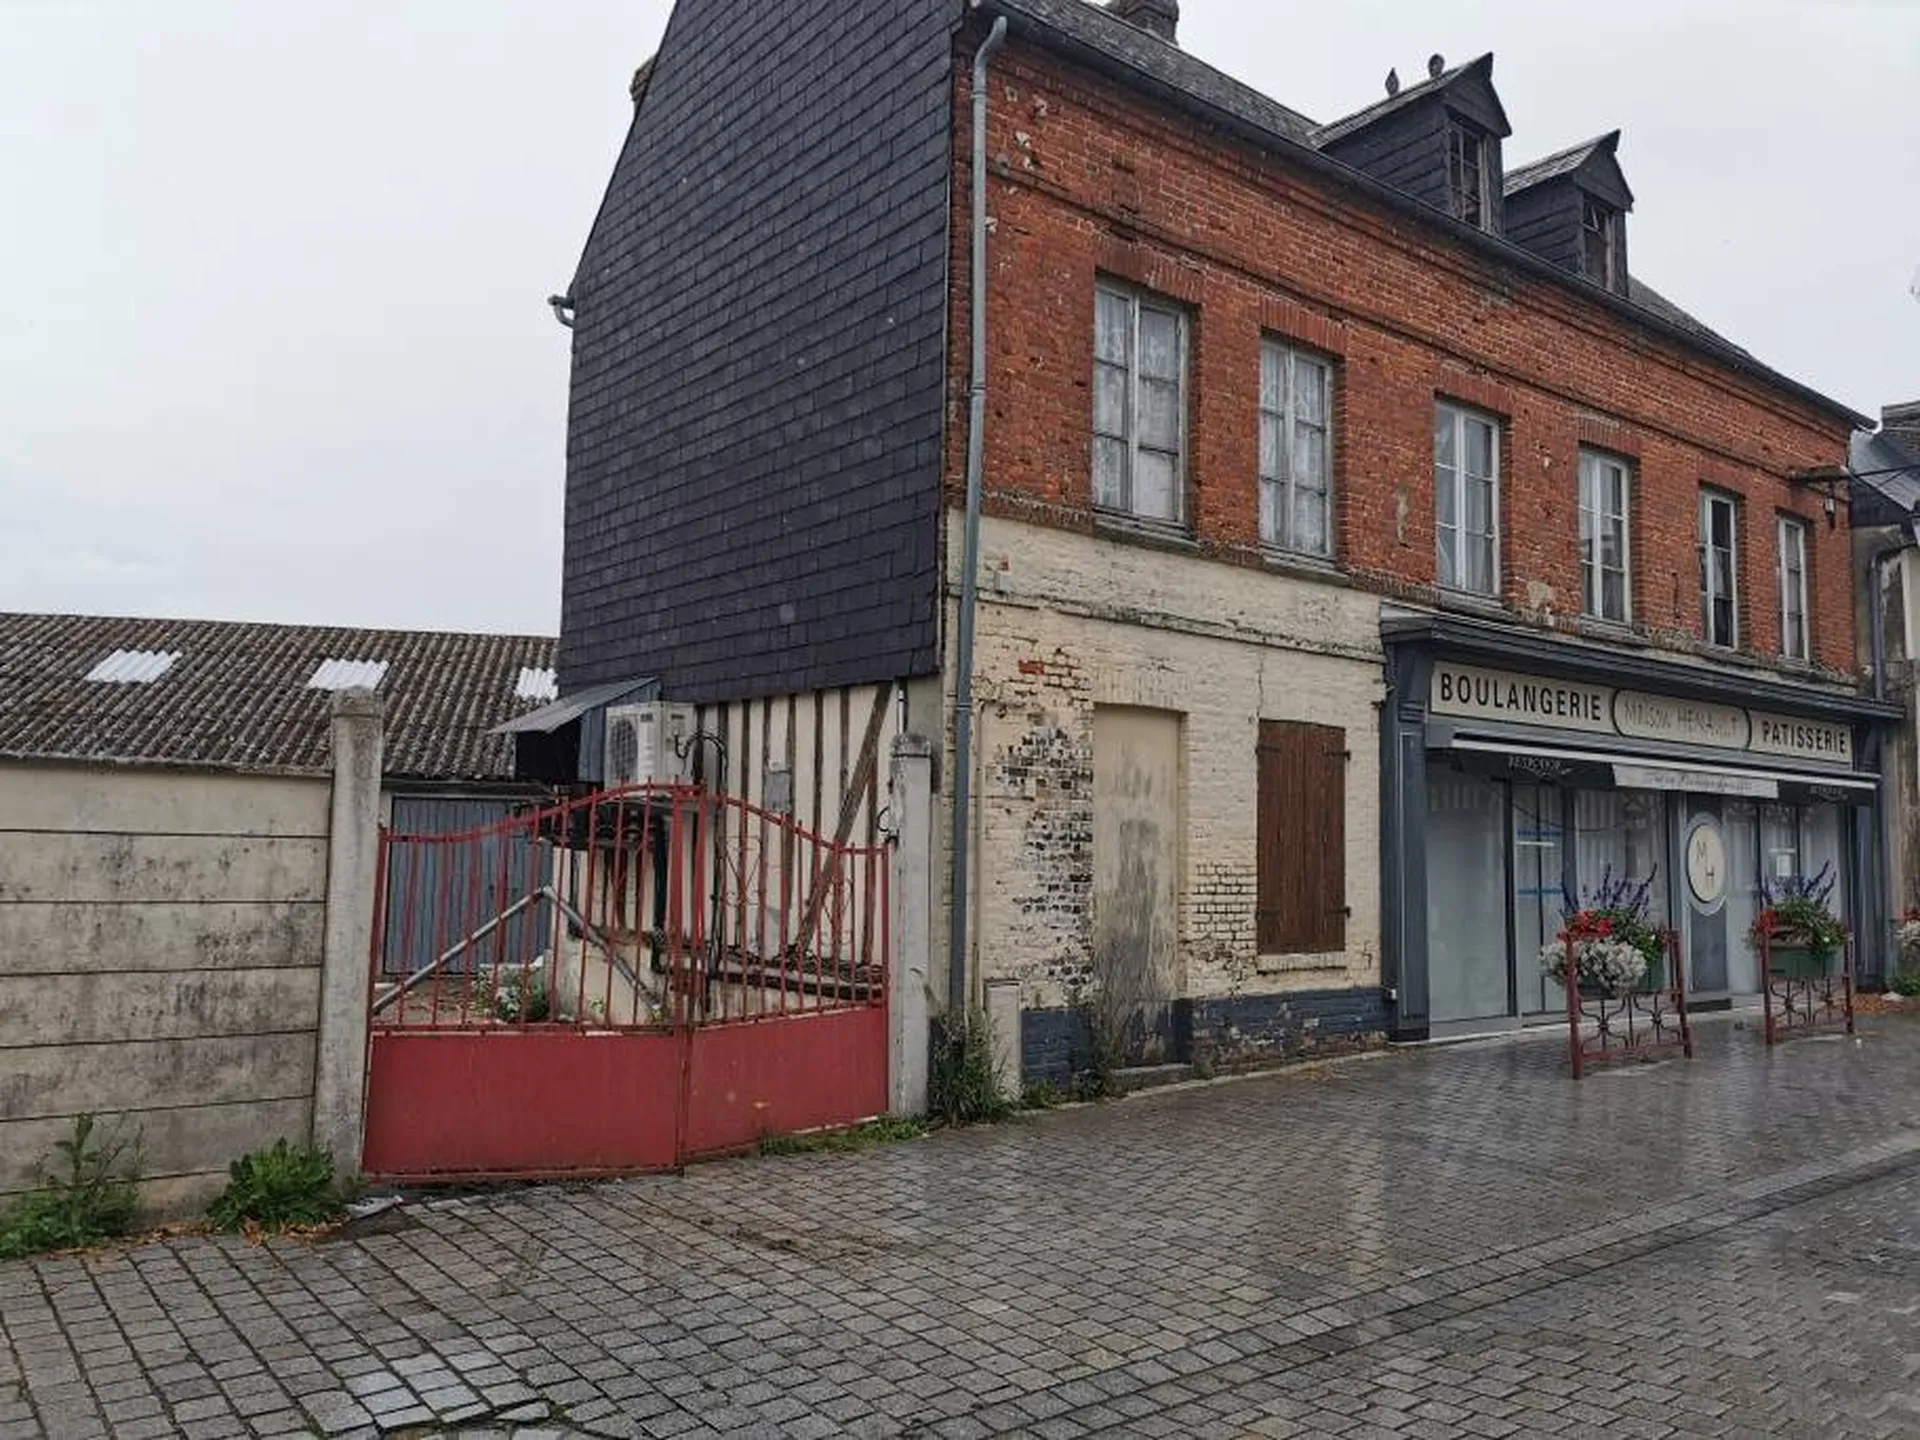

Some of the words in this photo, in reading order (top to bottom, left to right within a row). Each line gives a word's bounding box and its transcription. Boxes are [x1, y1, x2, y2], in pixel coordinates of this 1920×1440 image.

[1440, 672, 1601, 721] BOULANGERIE
[1762, 719, 1847, 754] PATISSERIE
[1696, 839, 1708, 862] M
[1704, 864, 1716, 892] H
